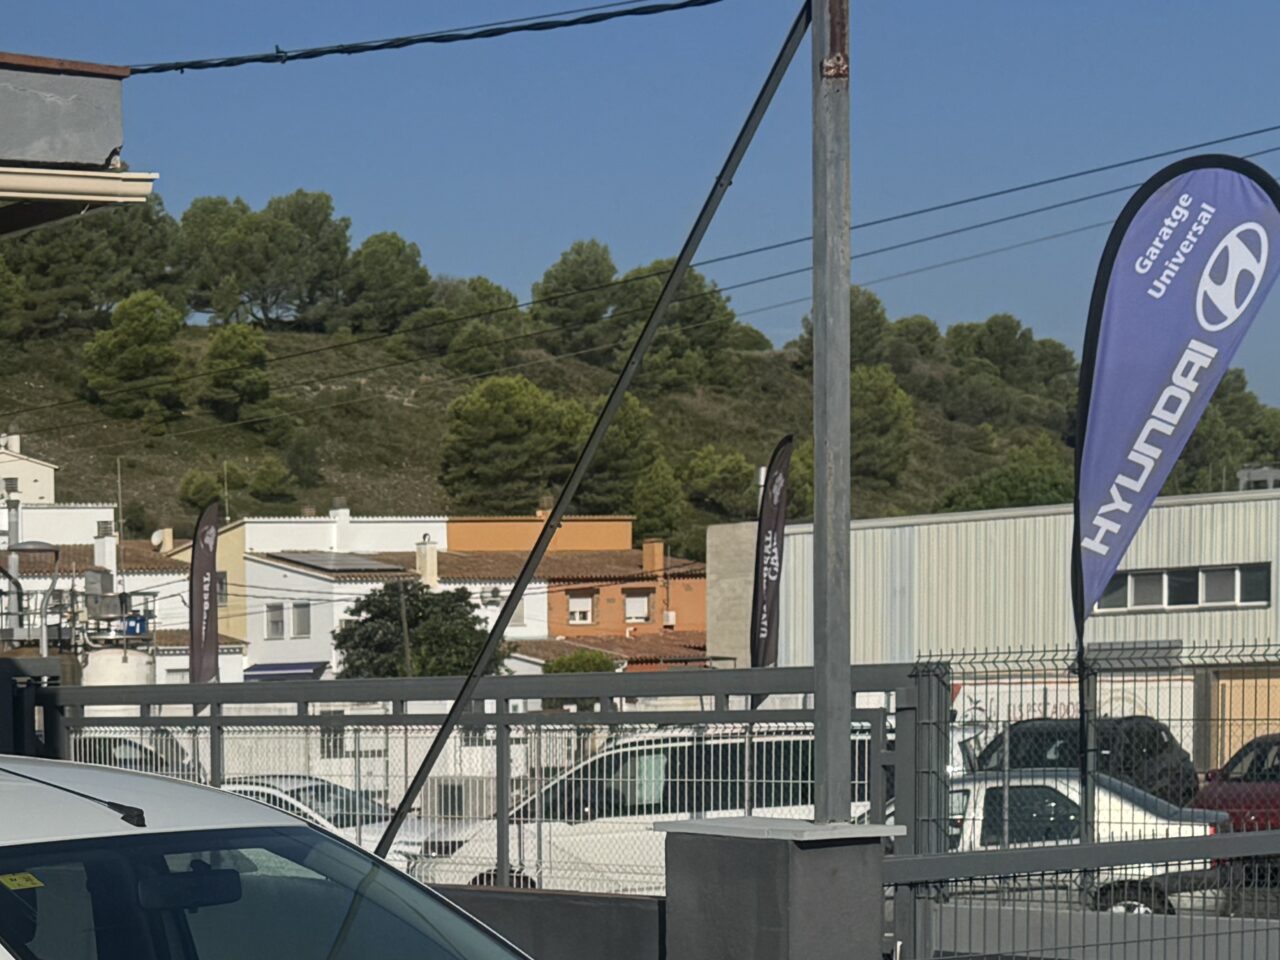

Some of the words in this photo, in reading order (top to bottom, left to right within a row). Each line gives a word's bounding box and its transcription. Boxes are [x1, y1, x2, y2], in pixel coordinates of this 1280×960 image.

[1135, 193, 1193, 274] Garatge
[1147, 202, 1216, 299] Universal
[1081, 339, 1218, 556] HYUNDAI
